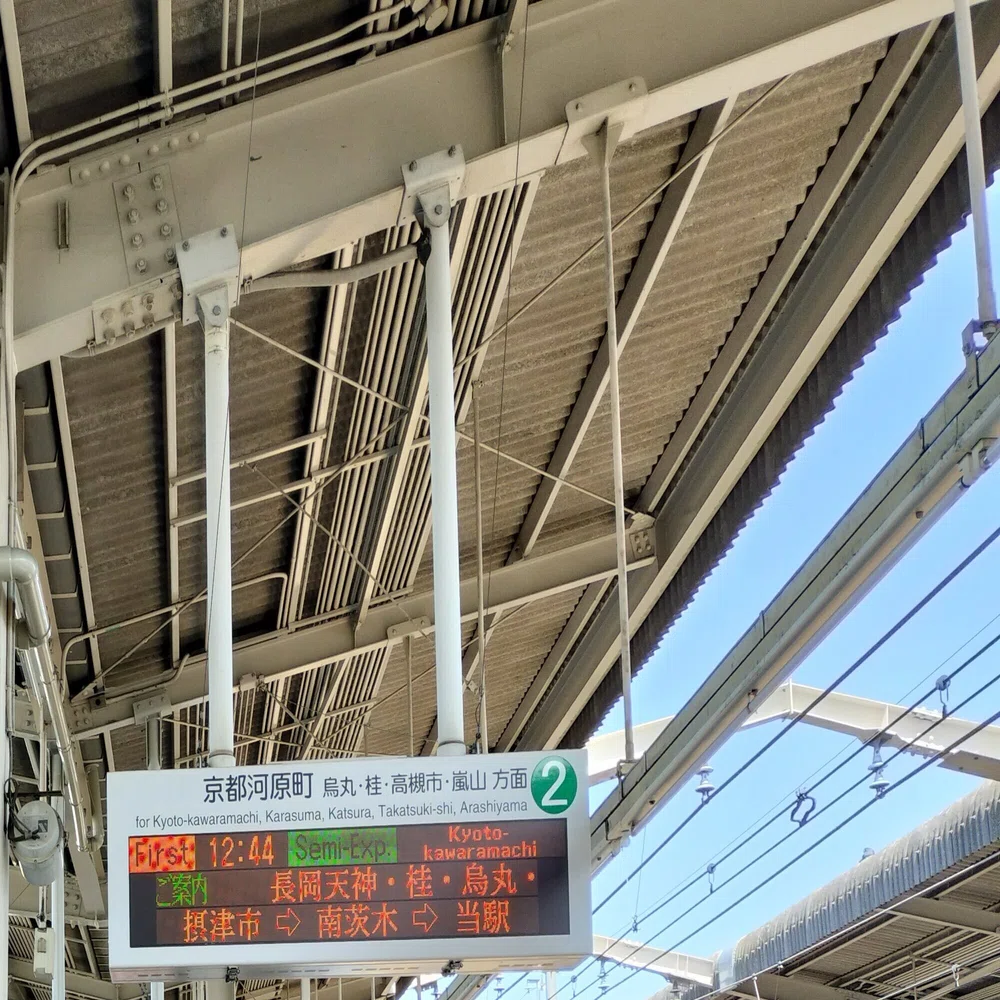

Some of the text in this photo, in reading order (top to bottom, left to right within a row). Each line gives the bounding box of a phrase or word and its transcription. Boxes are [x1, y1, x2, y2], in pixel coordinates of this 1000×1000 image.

[203, 772, 313, 803] 京都河原町
[492, 768, 527, 790] 方面
[541, 760, 568, 807] 2
[136, 800, 528, 830] for Kyoto-kawaramachi, Karasuma, Katsura, Takatsuki-shi, Arashiyama
[134, 833, 391, 867] First 12:44 Semi-Exp.
[423, 841, 537, 861] kawaramachi
[448, 826, 509, 843] Kyoto-
[156, 872, 208, 907] ご案内
[183, 900, 511, 943] 摂津市 南茨木 当駅
